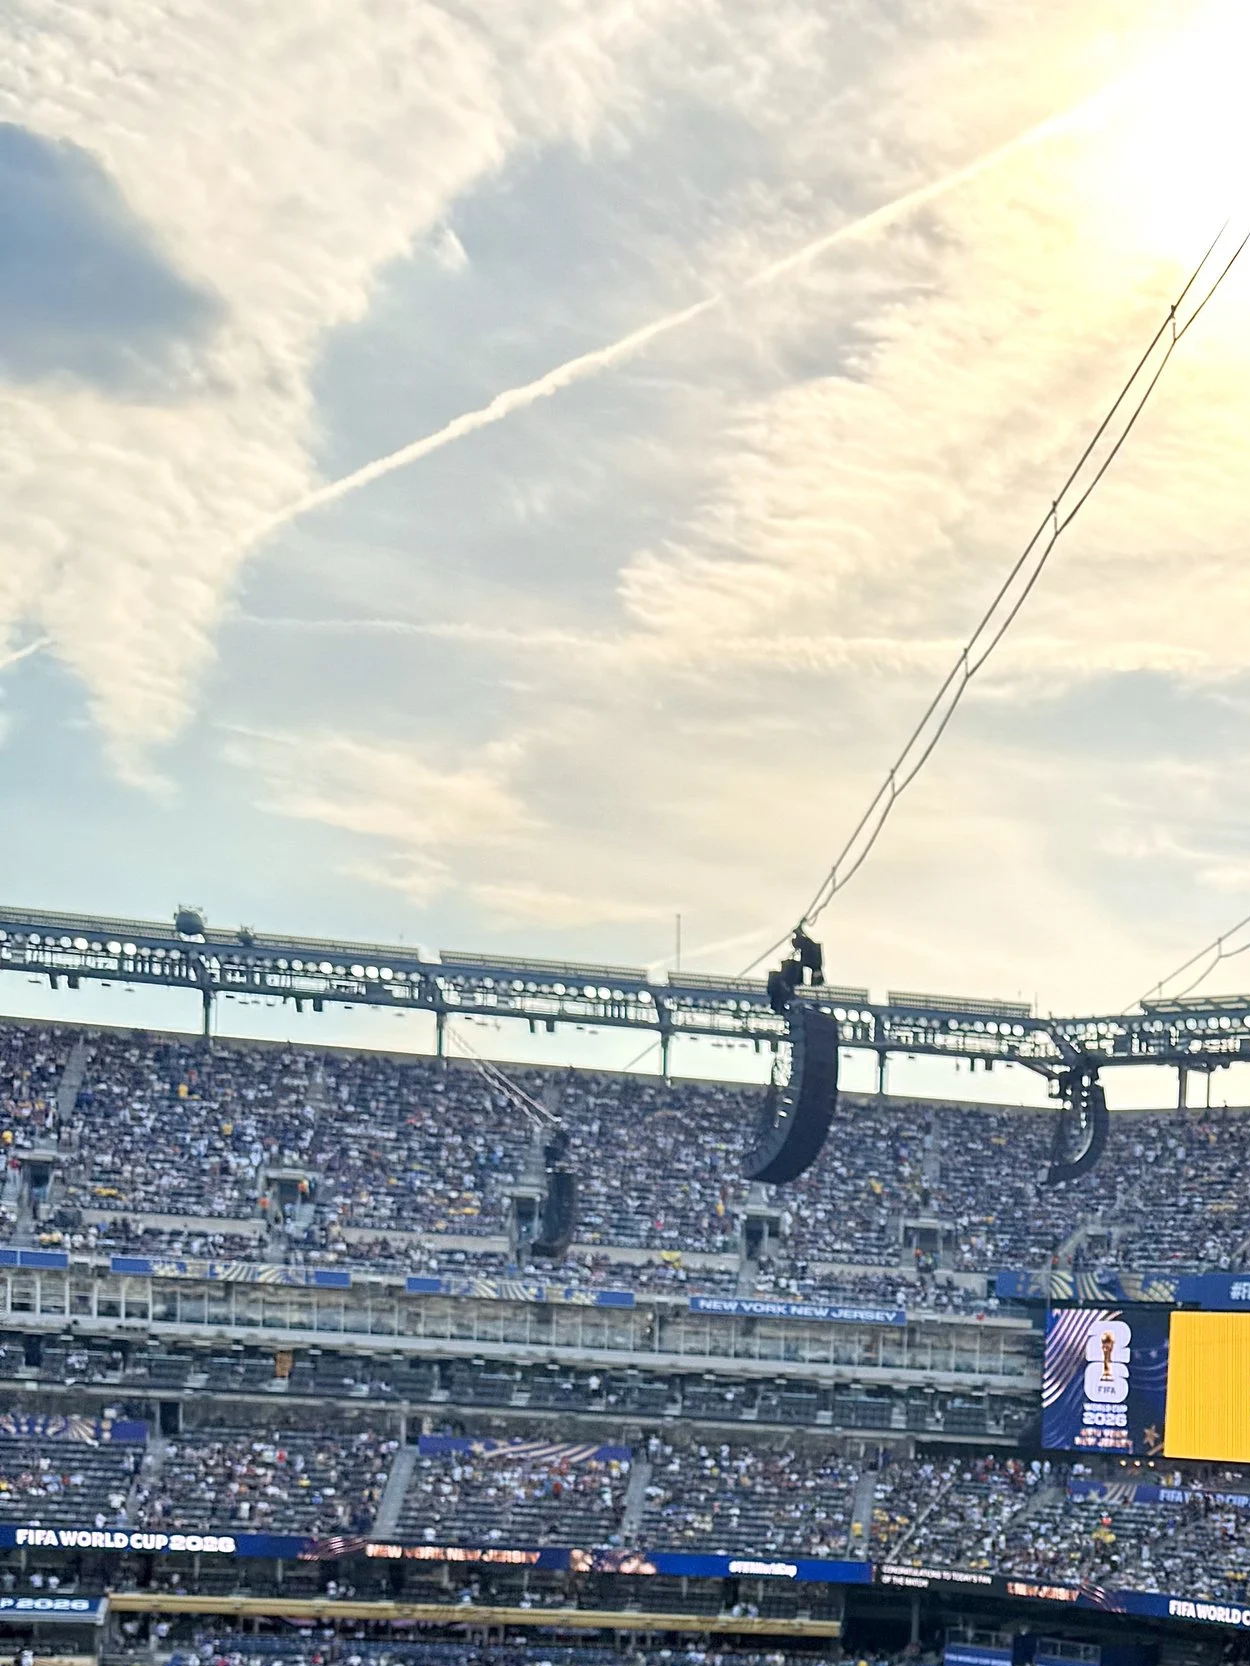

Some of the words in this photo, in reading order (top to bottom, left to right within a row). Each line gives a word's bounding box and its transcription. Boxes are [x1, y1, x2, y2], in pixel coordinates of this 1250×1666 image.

[700, 1299, 739, 1312] NEW
[740, 1301, 787, 1315] YORK
[790, 1304, 828, 1318] NEW
[830, 1308, 897, 1323] JERSEY
[1082, 1411, 1128, 1427] 2026
[16, 1528, 59, 1547] FIFA
[59, 1530, 129, 1549] WORLD
[130, 1533, 169, 1551] CUP
[168, 1535, 236, 1553] 2026
[16, 1597, 90, 1611] 2026
[1169, 1599, 1196, 1619] FIFA
[1197, 1603, 1241, 1625] WORLD
